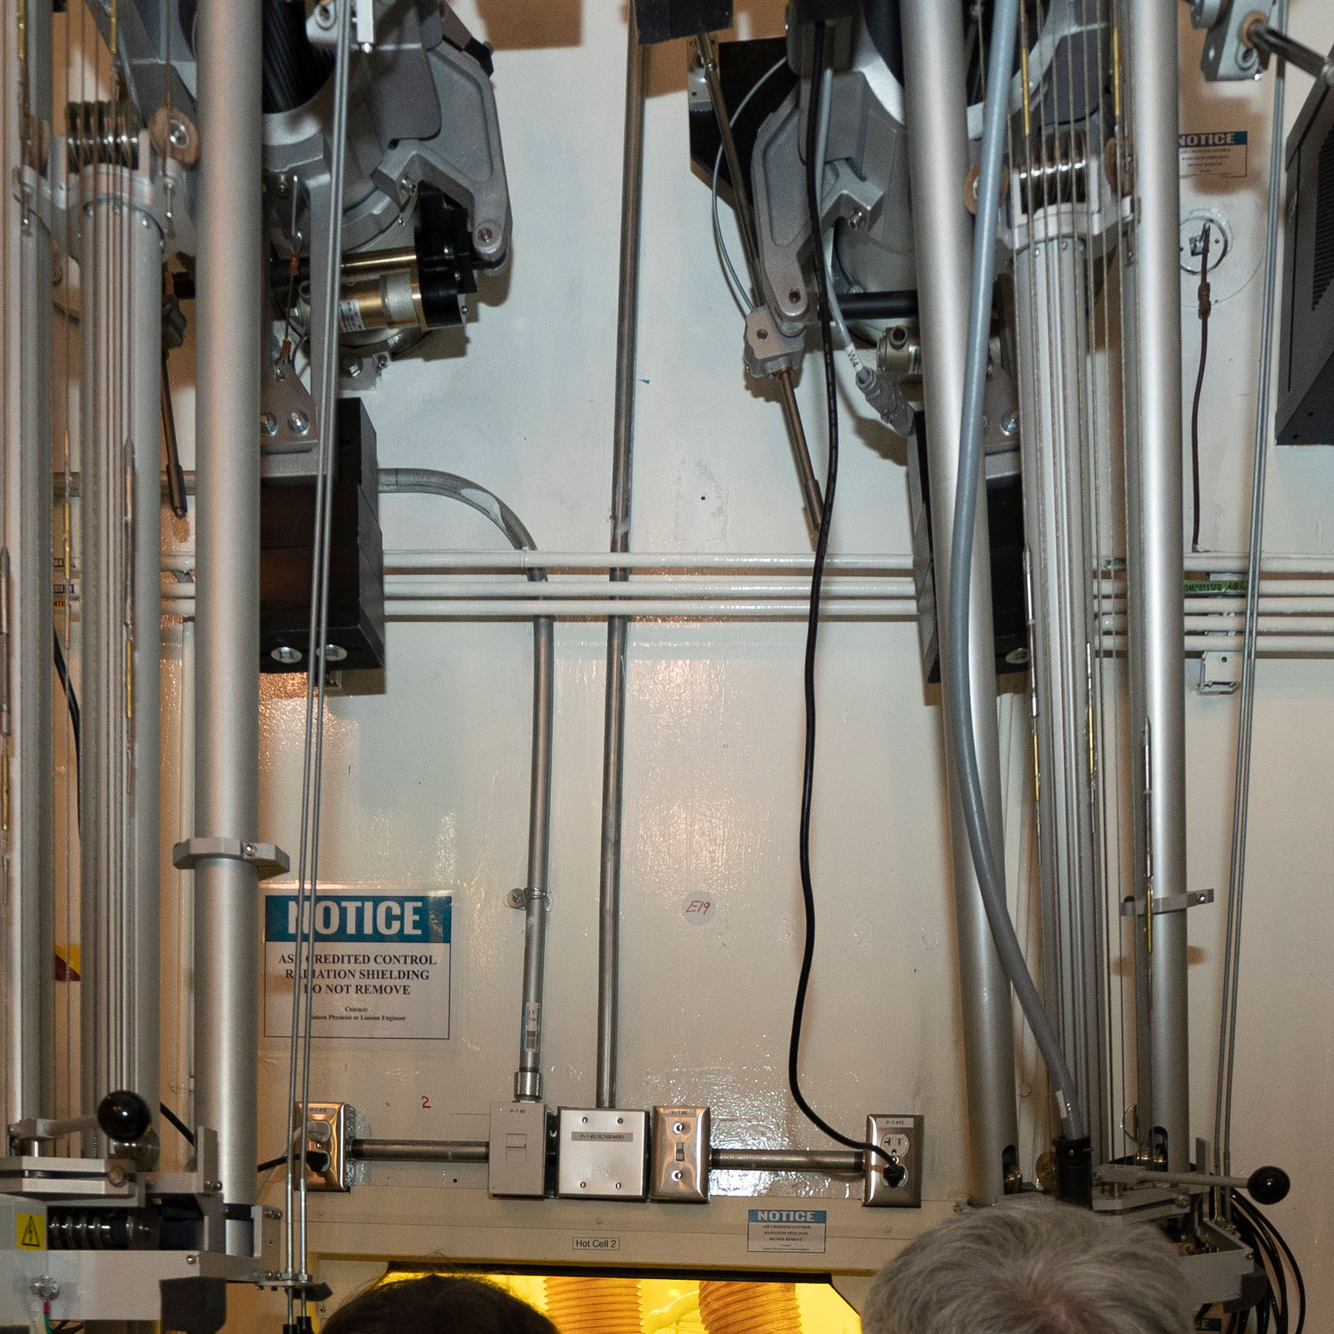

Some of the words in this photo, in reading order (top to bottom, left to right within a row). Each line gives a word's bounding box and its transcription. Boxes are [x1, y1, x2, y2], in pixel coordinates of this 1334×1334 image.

[373, 955, 437, 966] CONTROL
[359, 969, 430, 981] SHIELDING
[325, 984, 353, 995] NOT
[355, 984, 411, 995] REMOVE
[421, 1096, 431, 1109] 2
[757, 1211, 815, 1222] NOTICE
[575, 1239, 592, 1248] Hot
[592, 1239, 610, 1248] Cell
[610, 1240, 616, 1248] 2
